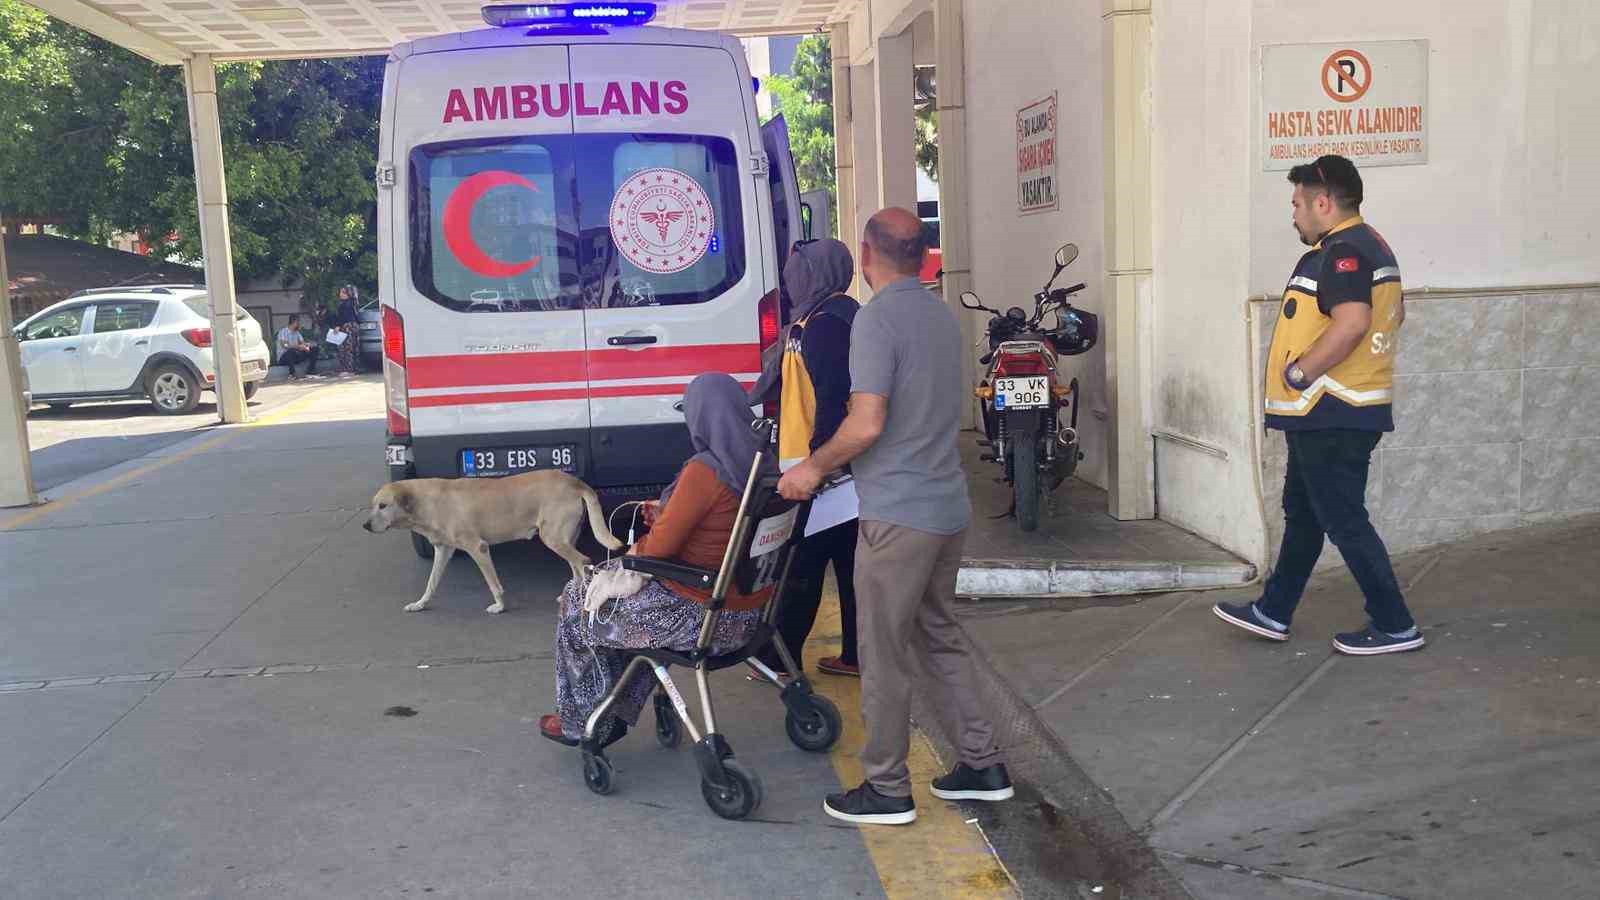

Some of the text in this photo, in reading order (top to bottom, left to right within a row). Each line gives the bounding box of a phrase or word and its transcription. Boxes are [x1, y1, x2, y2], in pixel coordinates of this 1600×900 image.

[442, 80, 689, 123] AMBULANS
[1268, 106, 1423, 138] HASTA SEVK ALANIDIR!
[998, 379, 1045, 391] 33 VK
[1014, 392, 1041, 404] 906
[475, 447, 572, 469] 33 EBS 96
